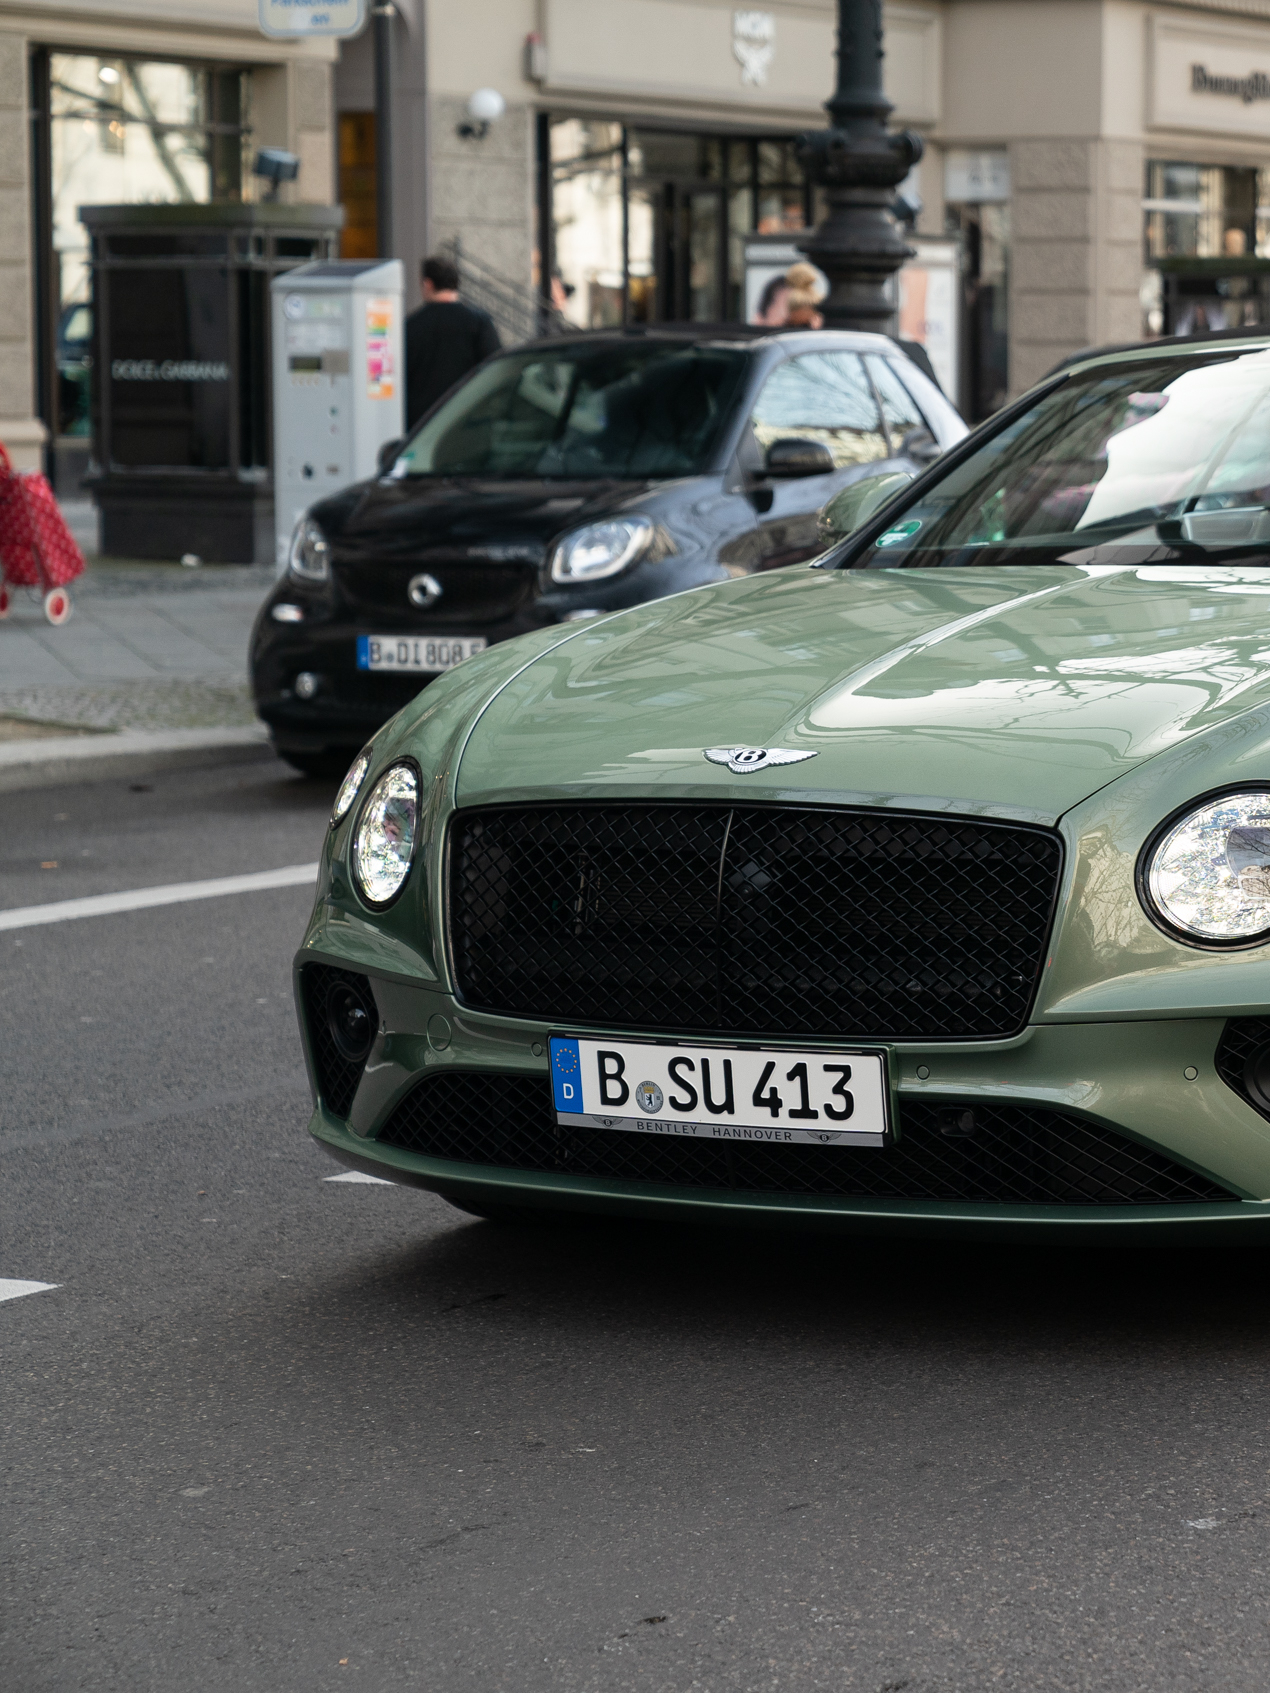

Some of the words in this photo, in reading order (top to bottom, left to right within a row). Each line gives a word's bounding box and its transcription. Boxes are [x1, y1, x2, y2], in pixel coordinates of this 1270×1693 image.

[562, 1083, 574, 1099] D
[597, 1050, 630, 1106] B
[667, 1056, 735, 1115] SU
[752, 1061, 854, 1120] 413
[636, 1121, 698, 1135] BENTLEY
[712, 1127, 792, 1141] HANNOVER
